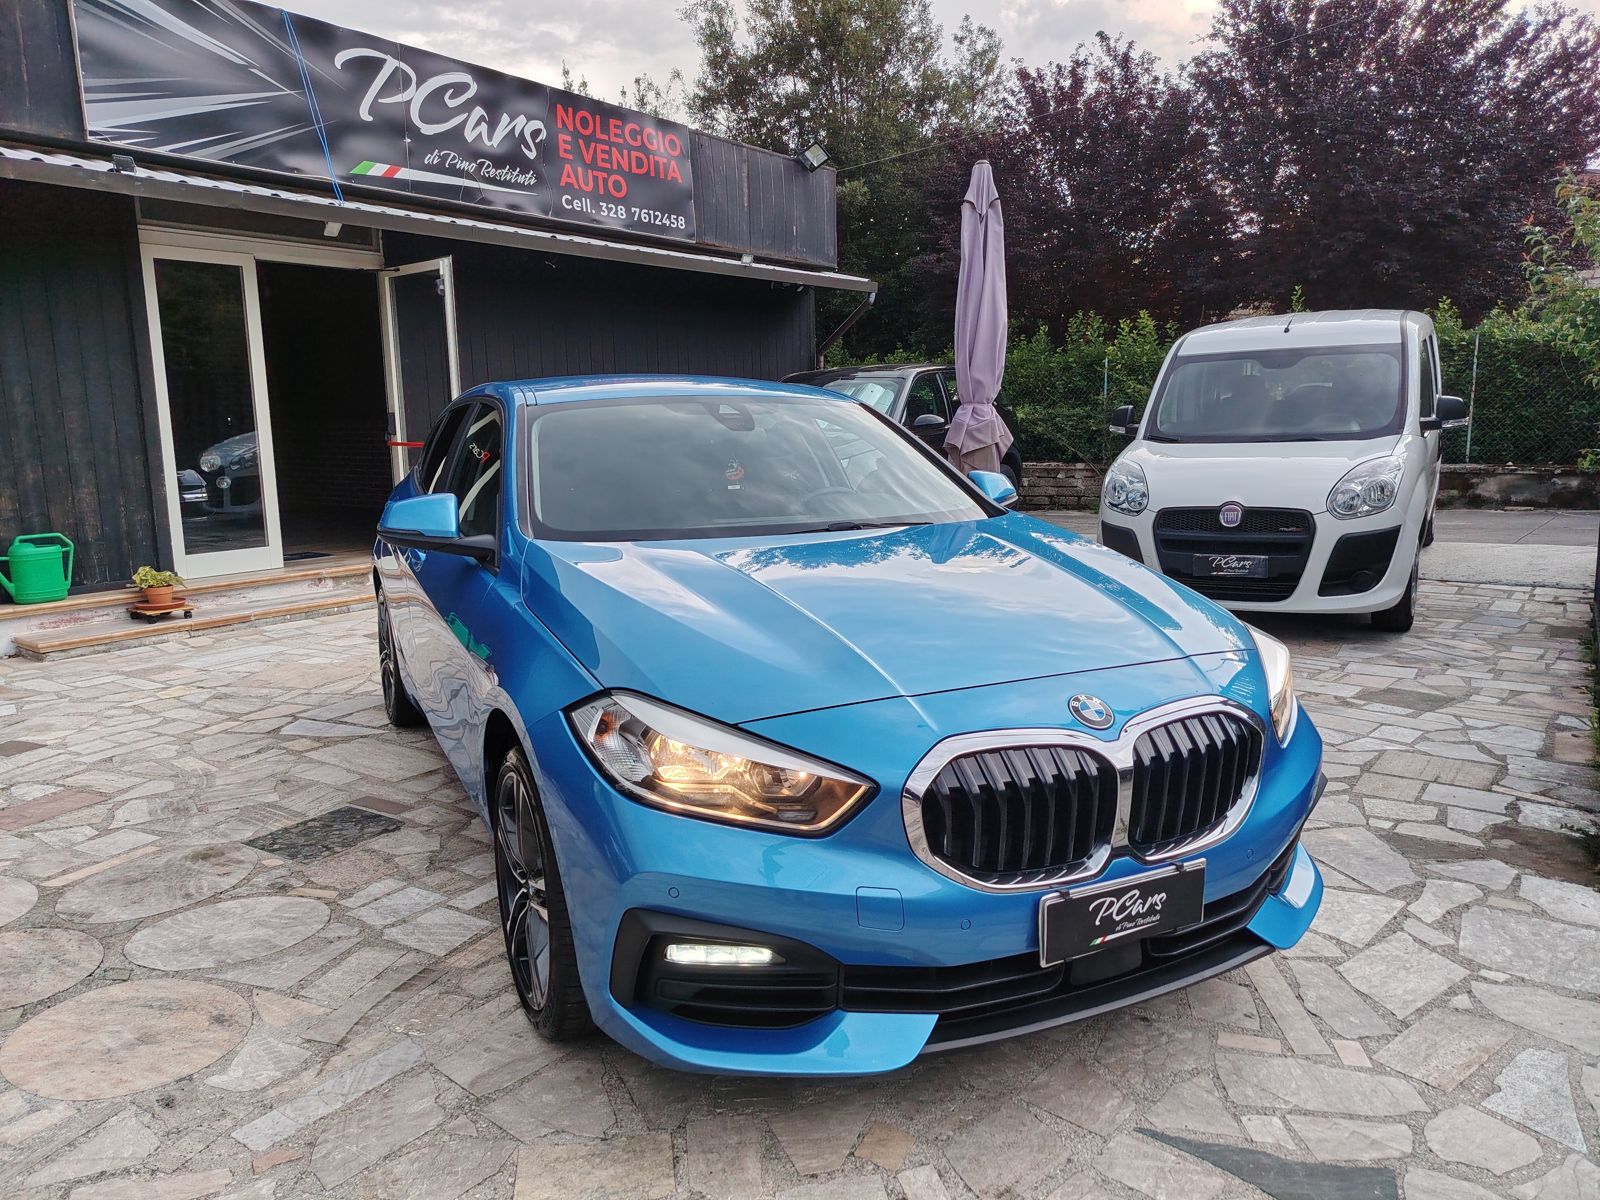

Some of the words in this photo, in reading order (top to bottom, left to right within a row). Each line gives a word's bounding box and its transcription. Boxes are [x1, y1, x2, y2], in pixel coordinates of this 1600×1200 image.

[334, 47, 547, 160] PCars
[556, 103, 681, 157] NOLEGGIO
[424, 149, 441, 165] di
[440, 150, 477, 172] Pino
[477, 158, 537, 186] Restituti
[558, 133, 573, 160] E
[578, 138, 683, 184] VENDITA
[560, 163, 628, 199] AUTO
[561, 194, 596, 214] Cell.
[599, 202, 627, 219] 328
[631, 207, 686, 229] 7612458
[1224, 511, 1238, 522] FIAT
[1208, 556, 1252, 568] PCars
[1089, 888, 1167, 926] PCars
